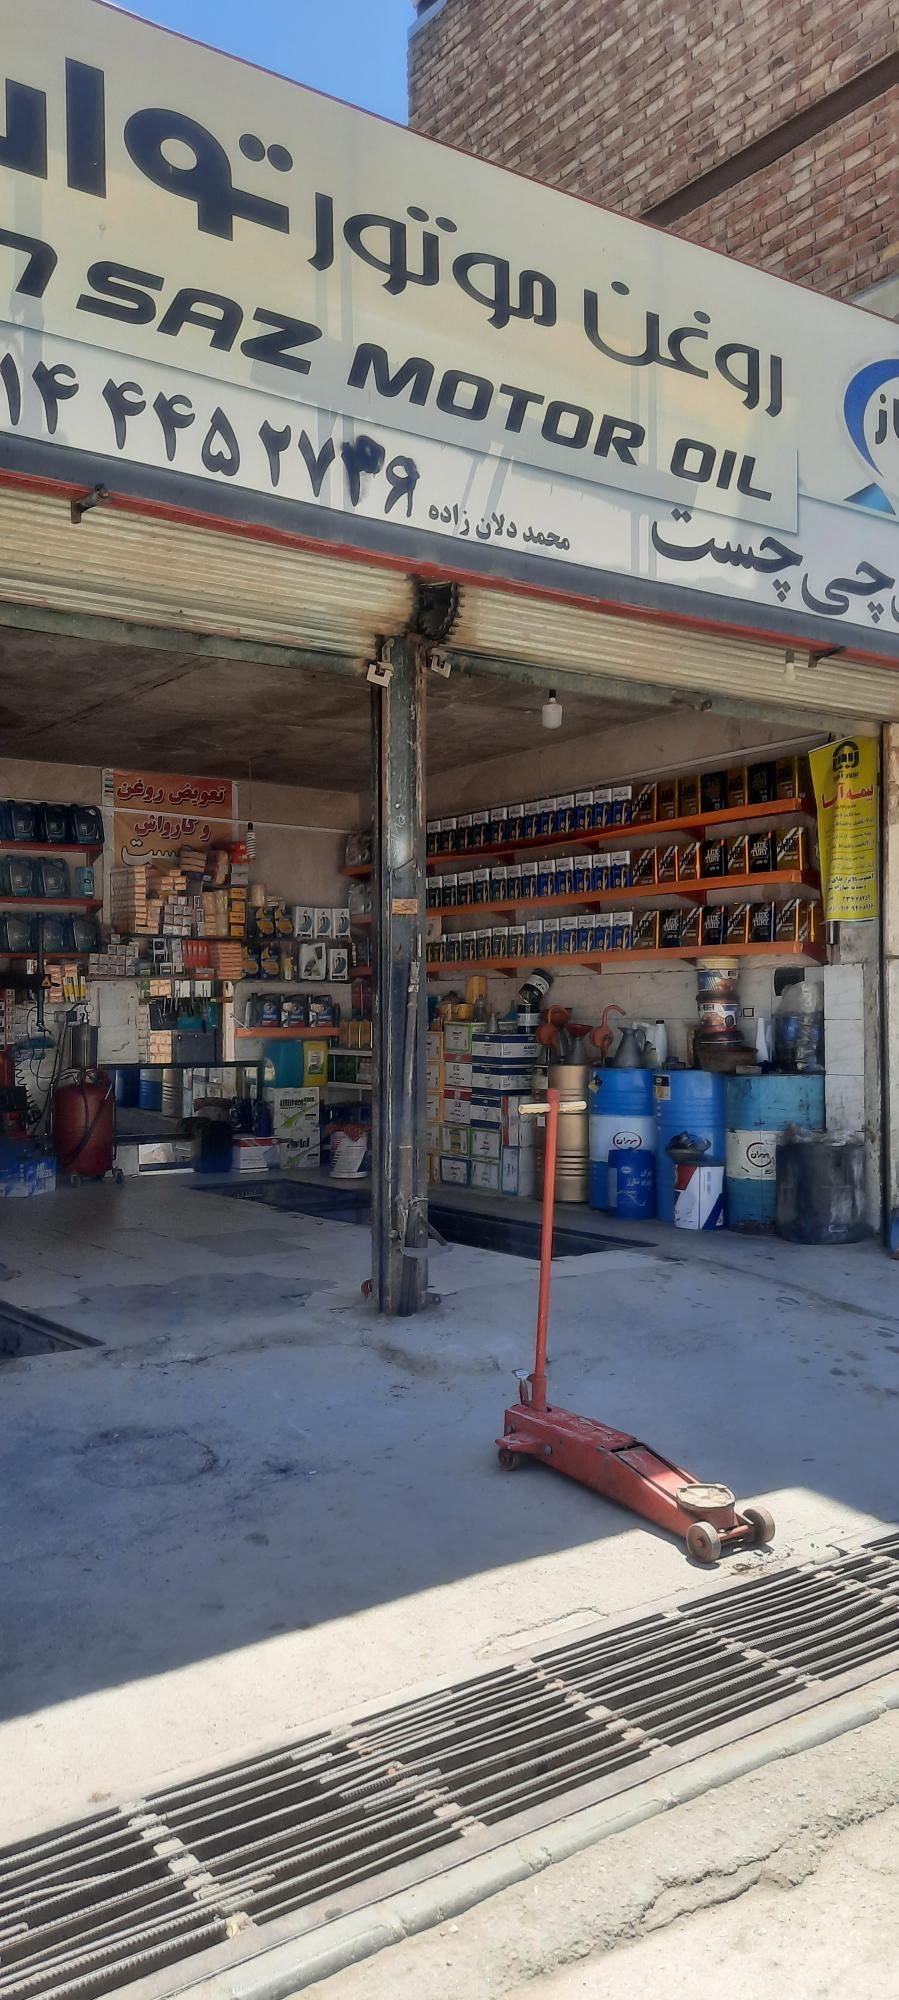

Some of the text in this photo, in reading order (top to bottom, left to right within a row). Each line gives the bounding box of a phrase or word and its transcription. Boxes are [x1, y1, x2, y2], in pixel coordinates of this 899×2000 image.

[308, 192, 557, 329] موتور
[76, 260, 323, 375] SAZ
[347, 343, 646, 466] MOTOR
[670, 438, 772, 501] OIL
[584, 281, 783, 417] روغن
[428, 503, 570, 550] محمد دلان زاده
[651, 507, 803, 602] چست
[116, 778, 227, 807] تعویض روغن
[134, 814, 212, 842] و کارواش
